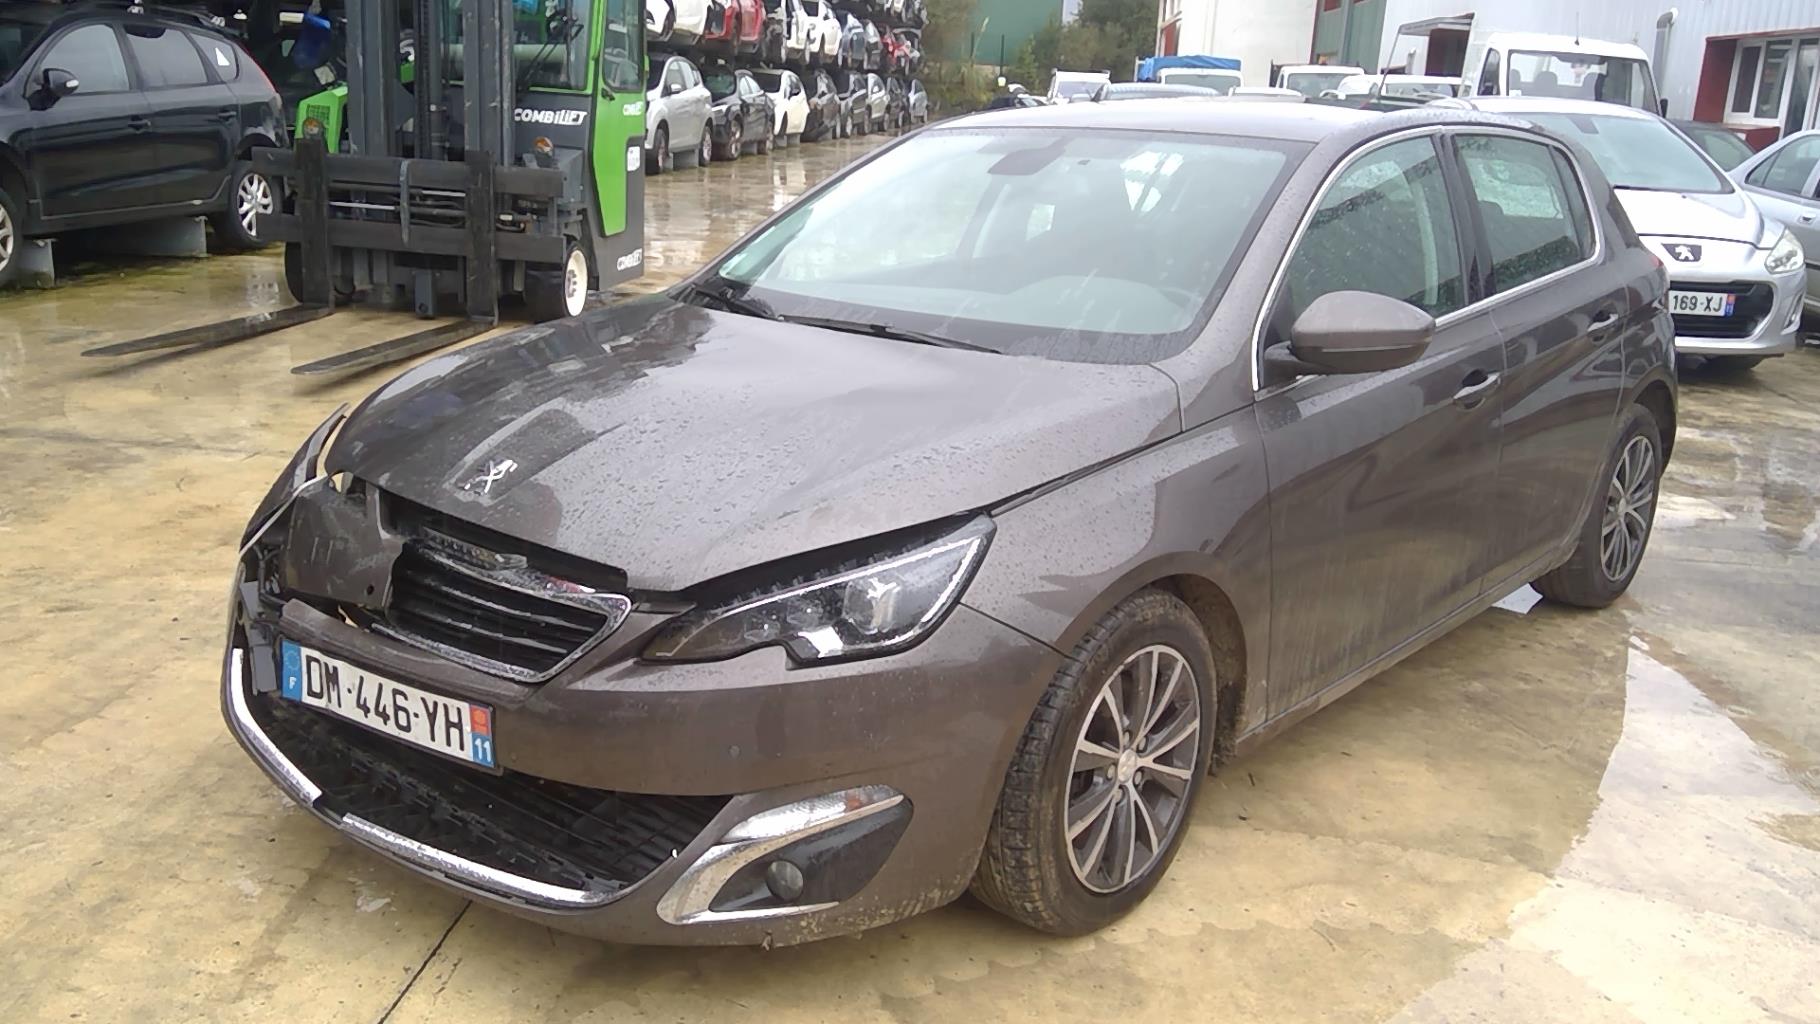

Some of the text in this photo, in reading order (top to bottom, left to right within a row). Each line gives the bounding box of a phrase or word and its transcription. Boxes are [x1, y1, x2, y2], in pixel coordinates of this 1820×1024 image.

[1673, 295, 1723, 312] 169-XJ
[289, 654, 493, 763] F DM-446-YH 11
